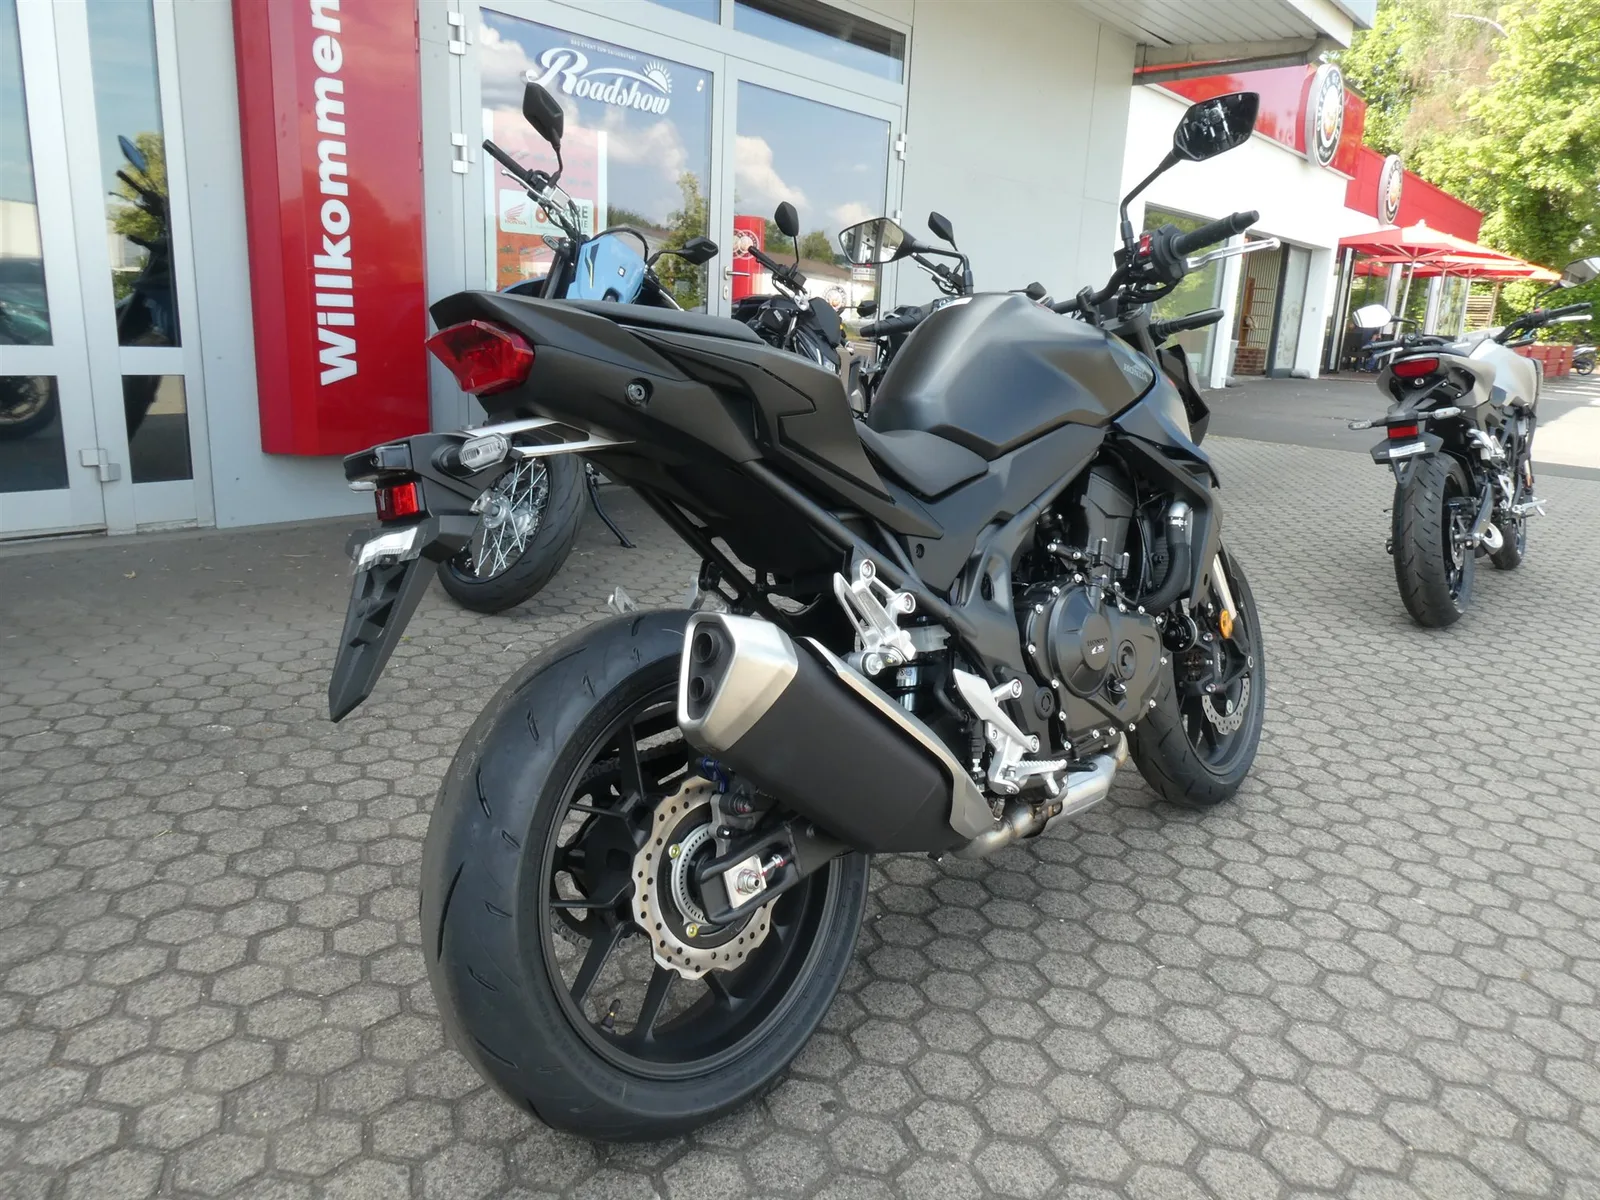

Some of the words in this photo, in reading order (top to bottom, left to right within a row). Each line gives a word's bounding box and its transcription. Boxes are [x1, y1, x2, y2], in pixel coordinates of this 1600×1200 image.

[525, 47, 671, 115] Roadshow
[309, 0, 358, 387] Willkommen
[1123, 362, 1148, 383] HONDA
[1087, 636, 1109, 647] HONDA
